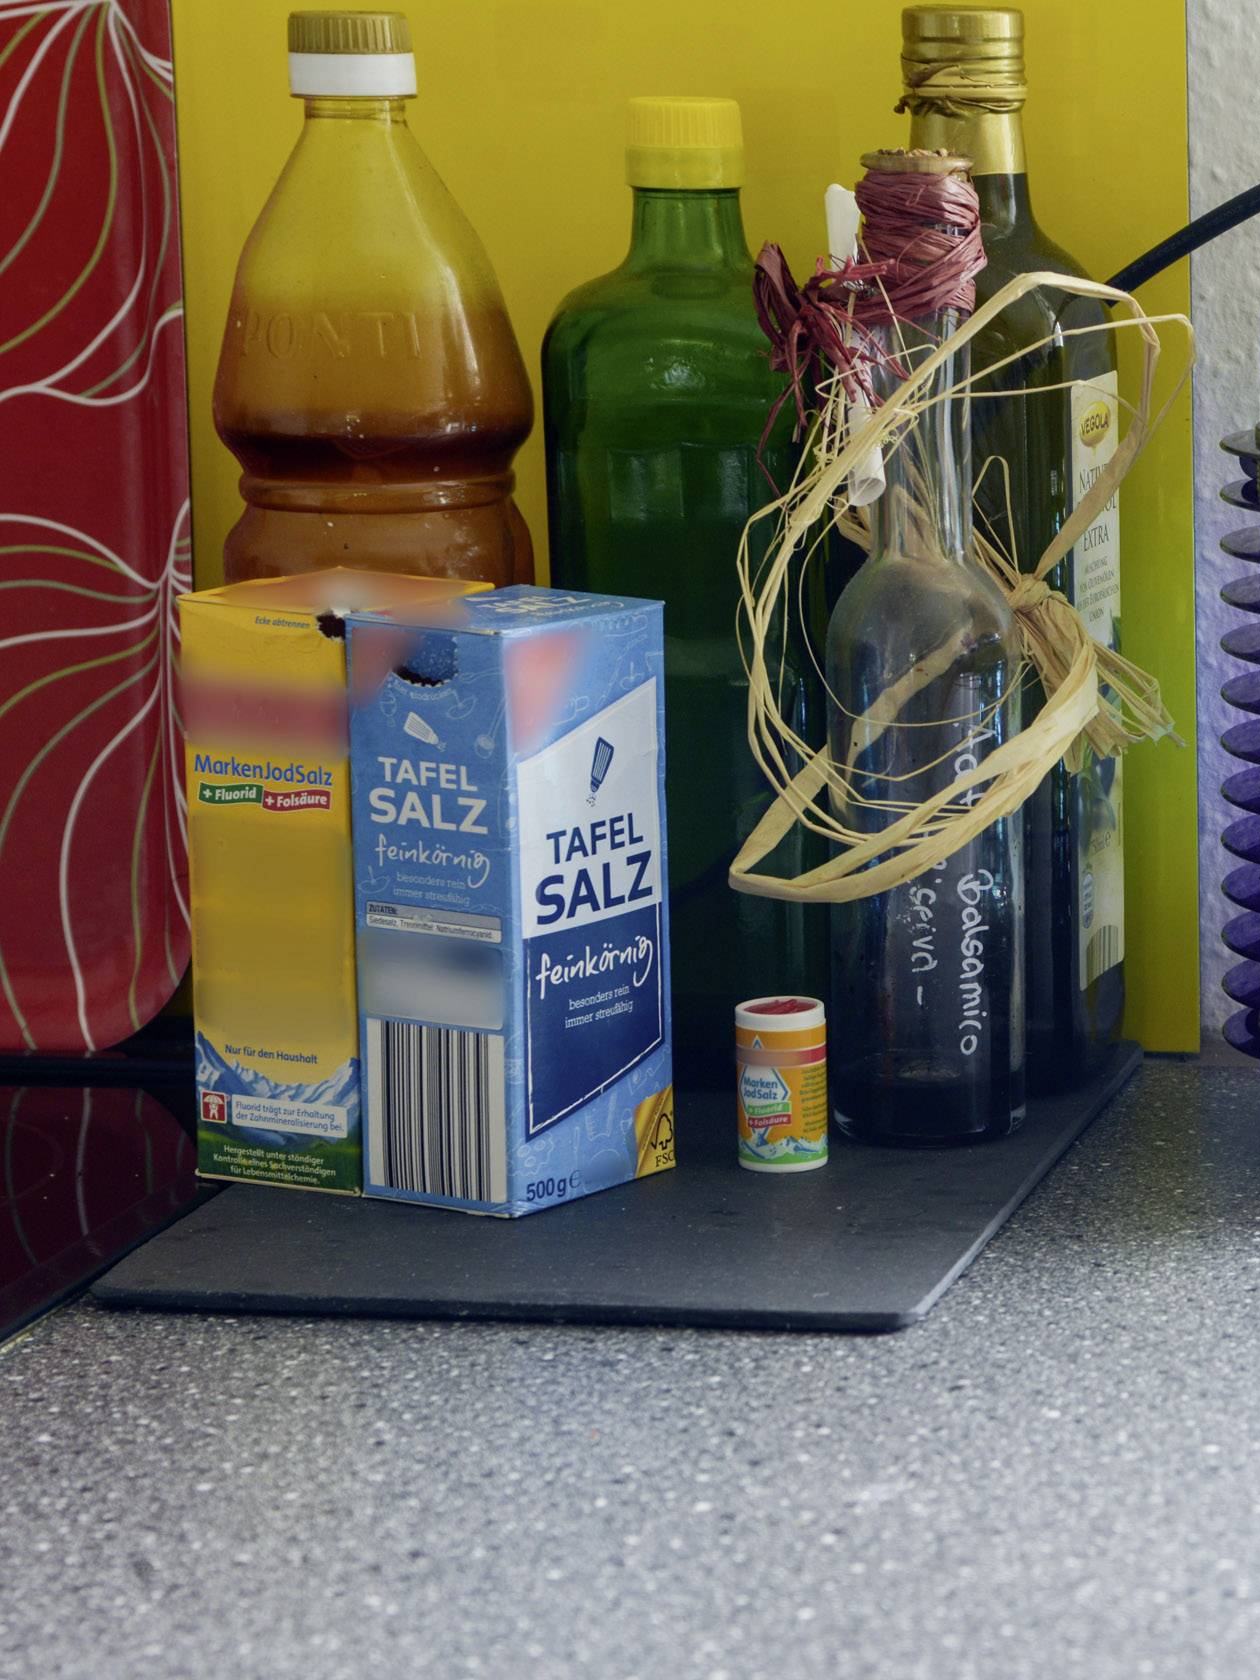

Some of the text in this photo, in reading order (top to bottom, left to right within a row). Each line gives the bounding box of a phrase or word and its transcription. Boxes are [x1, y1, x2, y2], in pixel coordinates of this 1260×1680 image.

[1080, 412, 1110, 437] VEGOLA
[194, 753, 334, 787] MarkenJodSalz
[377, 756, 478, 792] TAFEL
[215, 786, 257, 801] Fluorid
[277, 792, 328, 808] Folsäure
[369, 787, 489, 834] SALZ
[546, 812, 644, 865] TAFEL
[375, 833, 491, 889] feinkörnig
[535, 850, 653, 925] SALZ
[536, 935, 653, 1000] feinkörnig
[956, 868, 994, 1056] Balsamico
[569, 985, 631, 1010] besonders rein
[565, 999, 634, 1029] immer streufähig
[224, 1044, 318, 1065] Nur für den Haushalt
[744, 1076, 778, 1089] Marken
[235, 1101, 336, 1122] Fluorid trägt zur Erhaltung
[235, 1110, 249, 1121] der
[249, 1112, 329, 1133] Zahnmineralisierung
[213, 1153, 337, 1177] Kontrolle eines Sachverständigen
[224, 1144, 324, 1166] Hergestellt unter ständiger
[655, 1150, 675, 1168] FSC
[229, 1164, 243, 1175] für
